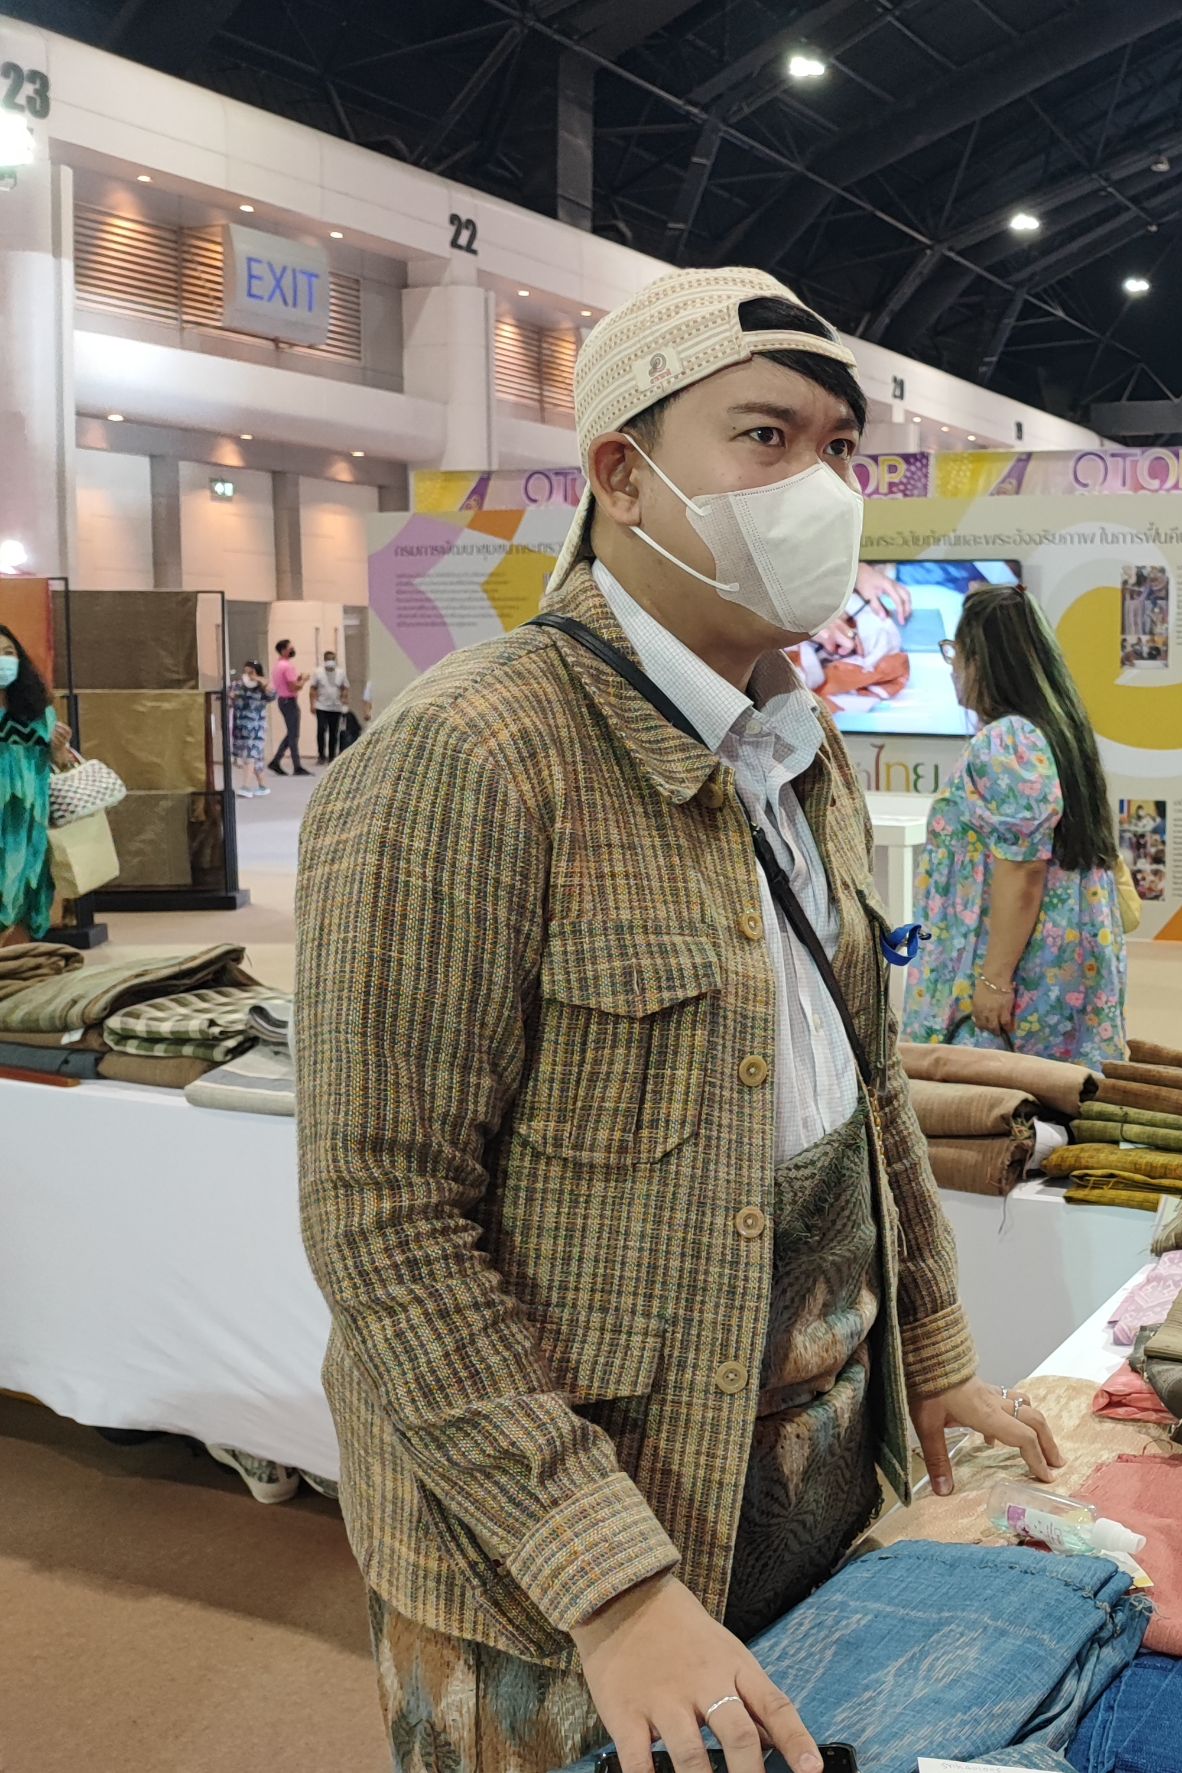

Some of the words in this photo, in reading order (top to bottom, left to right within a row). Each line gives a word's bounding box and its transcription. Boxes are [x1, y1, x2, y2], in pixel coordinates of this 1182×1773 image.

[1, 61, 50, 119] 23
[449, 214, 478, 255] 22
[246, 257, 320, 312] EXIT
[524, 471, 585, 504] OT
[852, 456, 905, 494] OP
[860, 743, 939, 793] าไทย
